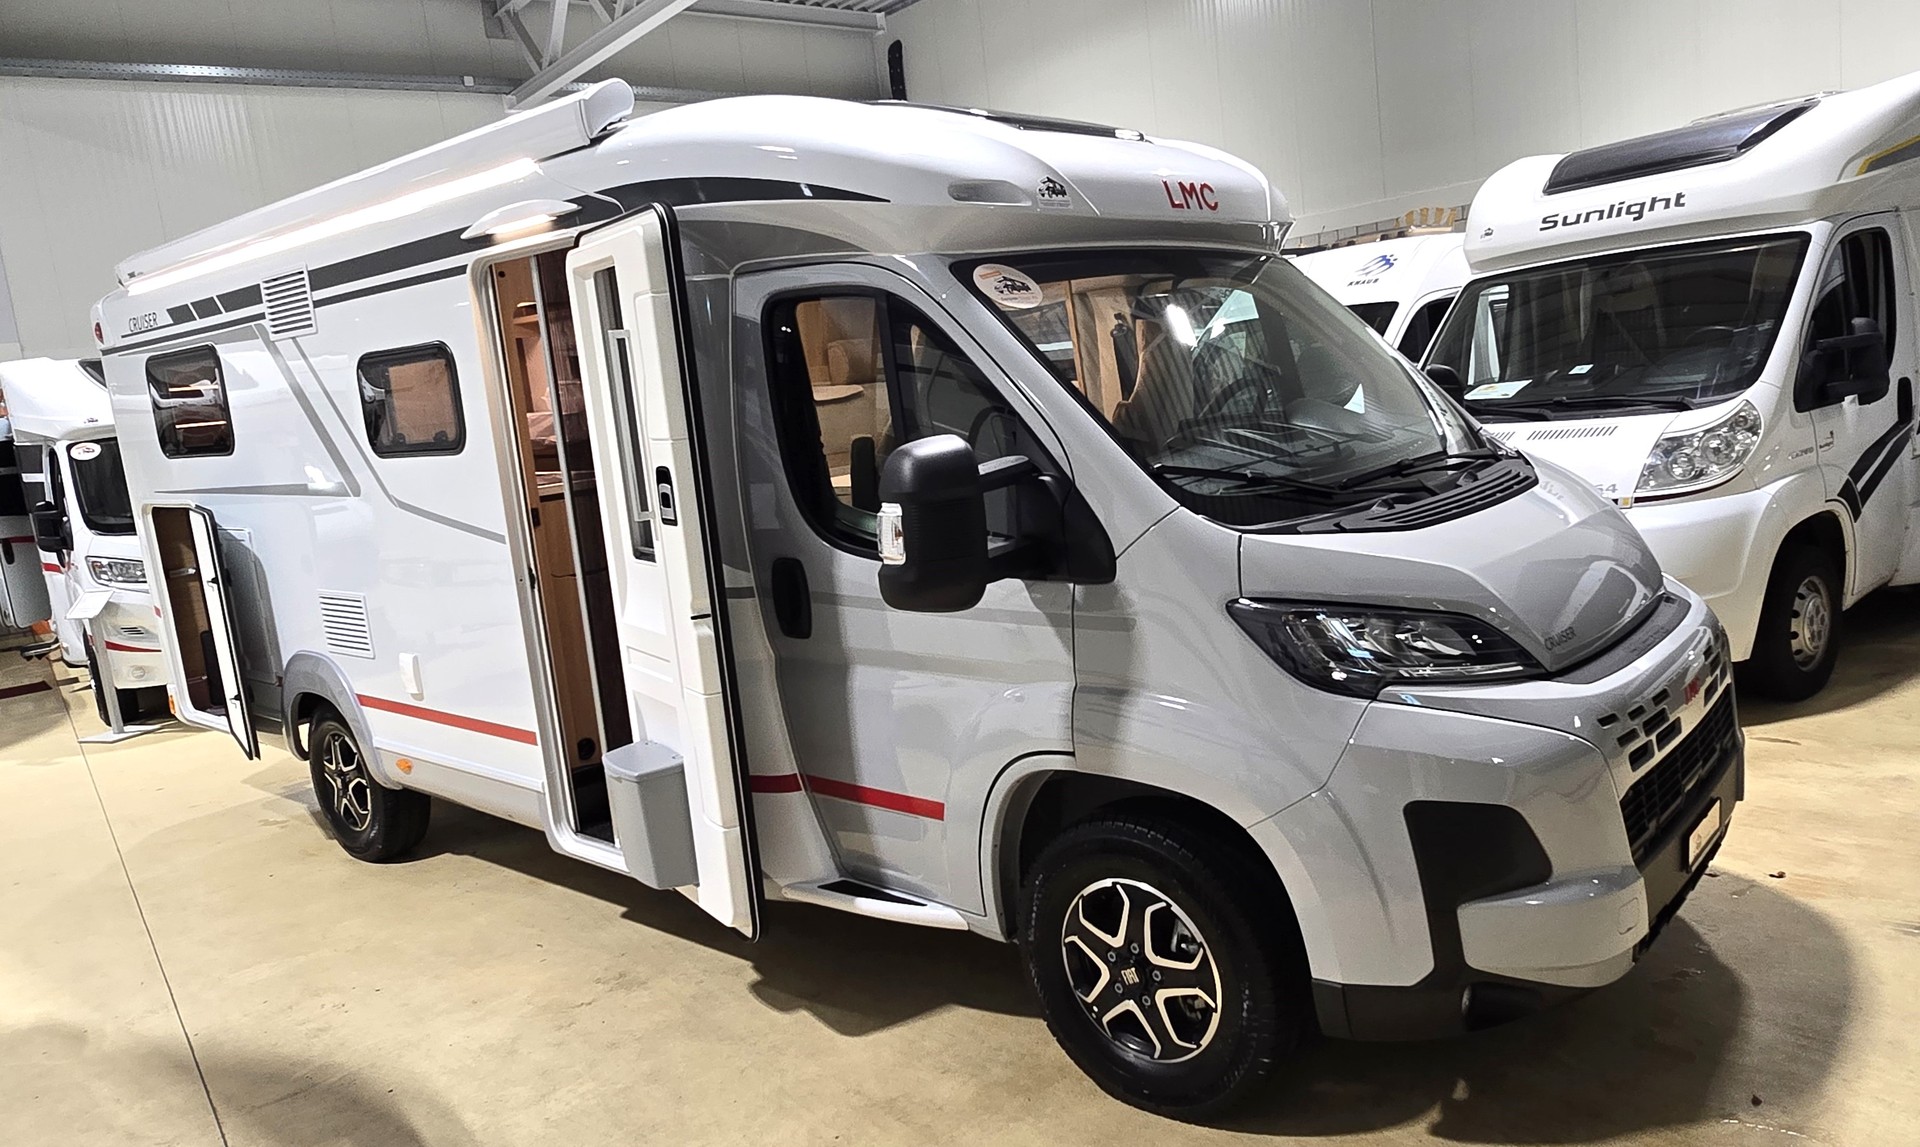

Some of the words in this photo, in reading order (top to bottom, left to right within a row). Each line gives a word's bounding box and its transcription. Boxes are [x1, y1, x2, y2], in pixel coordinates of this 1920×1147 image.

[1161, 179, 1219, 212] LMC
[1539, 192, 1686, 231] Sunlight
[128, 311, 158, 332] CRUISER
[1544, 626, 1577, 652] CRUISER
[1120, 966, 1140, 985] FIAT
